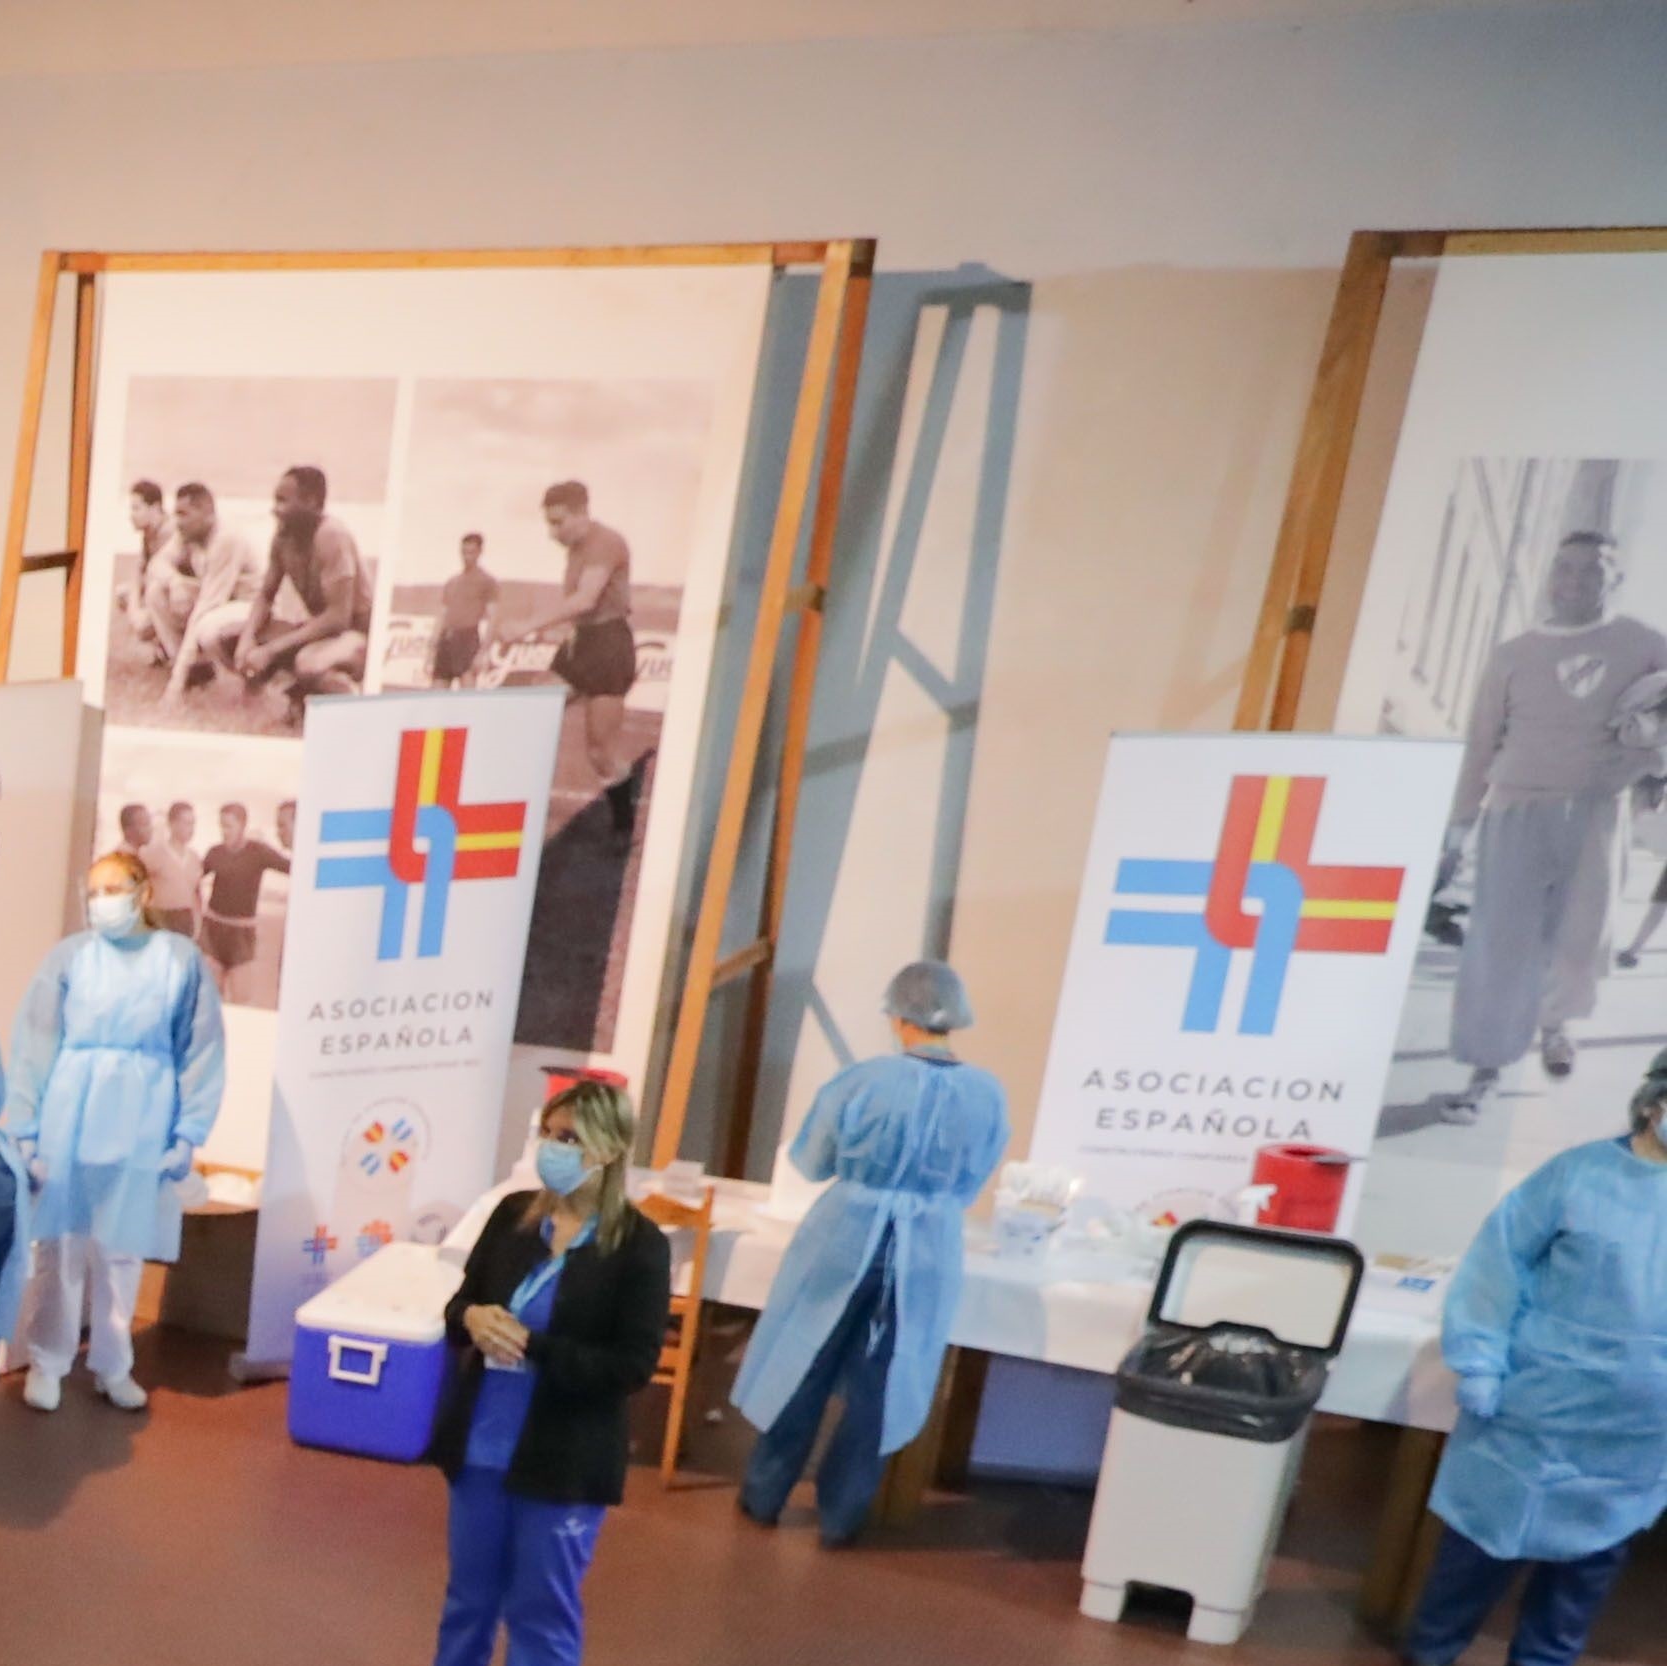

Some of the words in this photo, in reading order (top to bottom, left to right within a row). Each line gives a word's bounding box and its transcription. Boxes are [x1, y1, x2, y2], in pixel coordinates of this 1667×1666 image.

[307, 990, 494, 1022] ASOCIACION
[320, 1025, 474, 1056] ESPAÑOLA
[1081, 1069, 1345, 1103] ASOCIACION
[1095, 1108, 1313, 1141] ESPAÑOLA
